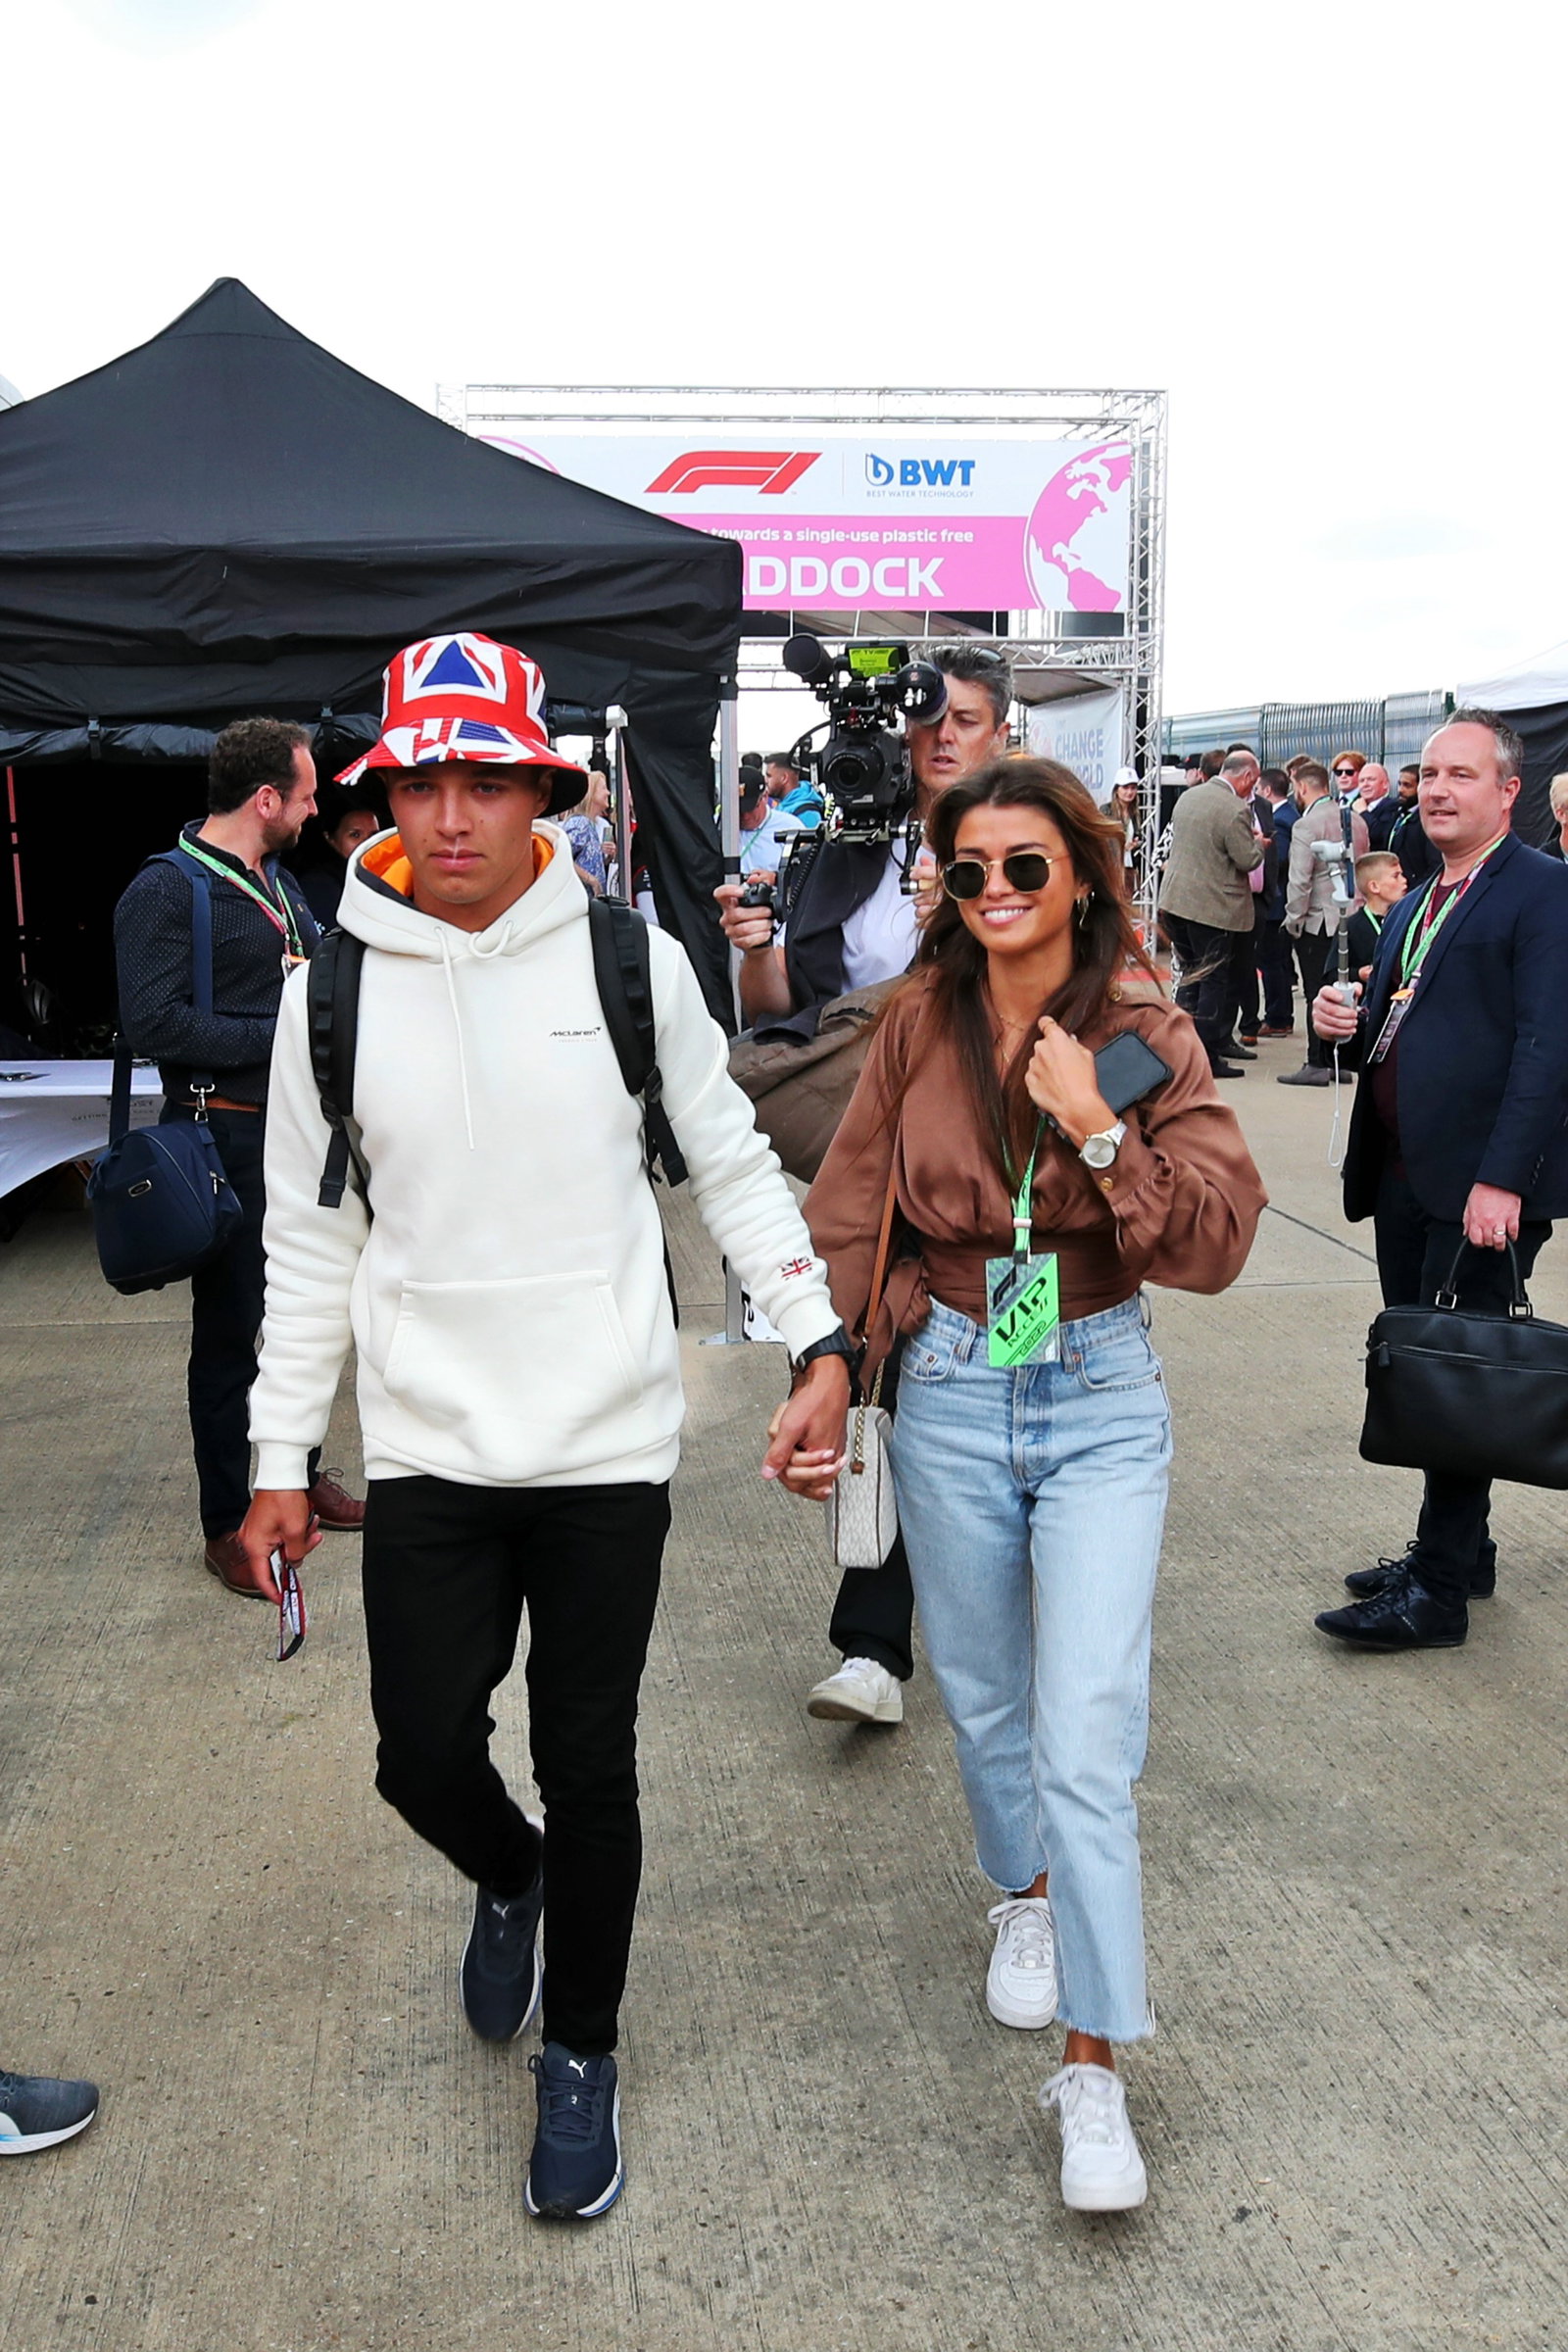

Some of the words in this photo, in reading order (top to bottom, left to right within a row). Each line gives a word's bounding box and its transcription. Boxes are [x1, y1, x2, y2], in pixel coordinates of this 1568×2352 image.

[643, 451, 823, 494] F1
[900, 460, 975, 486] BWT
[783, 529, 793, 541] a
[796, 527, 880, 544] single-use
[882, 528, 937, 545] plastic
[941, 528, 974, 542] free
[742, 556, 945, 597] DDOCK
[1055, 728, 1103, 760] CHANGE
[996, 1277, 1047, 1343] VIP
[1007, 1297, 1049, 1348] ACCESS
[1020, 1320, 1047, 1356] 2022
